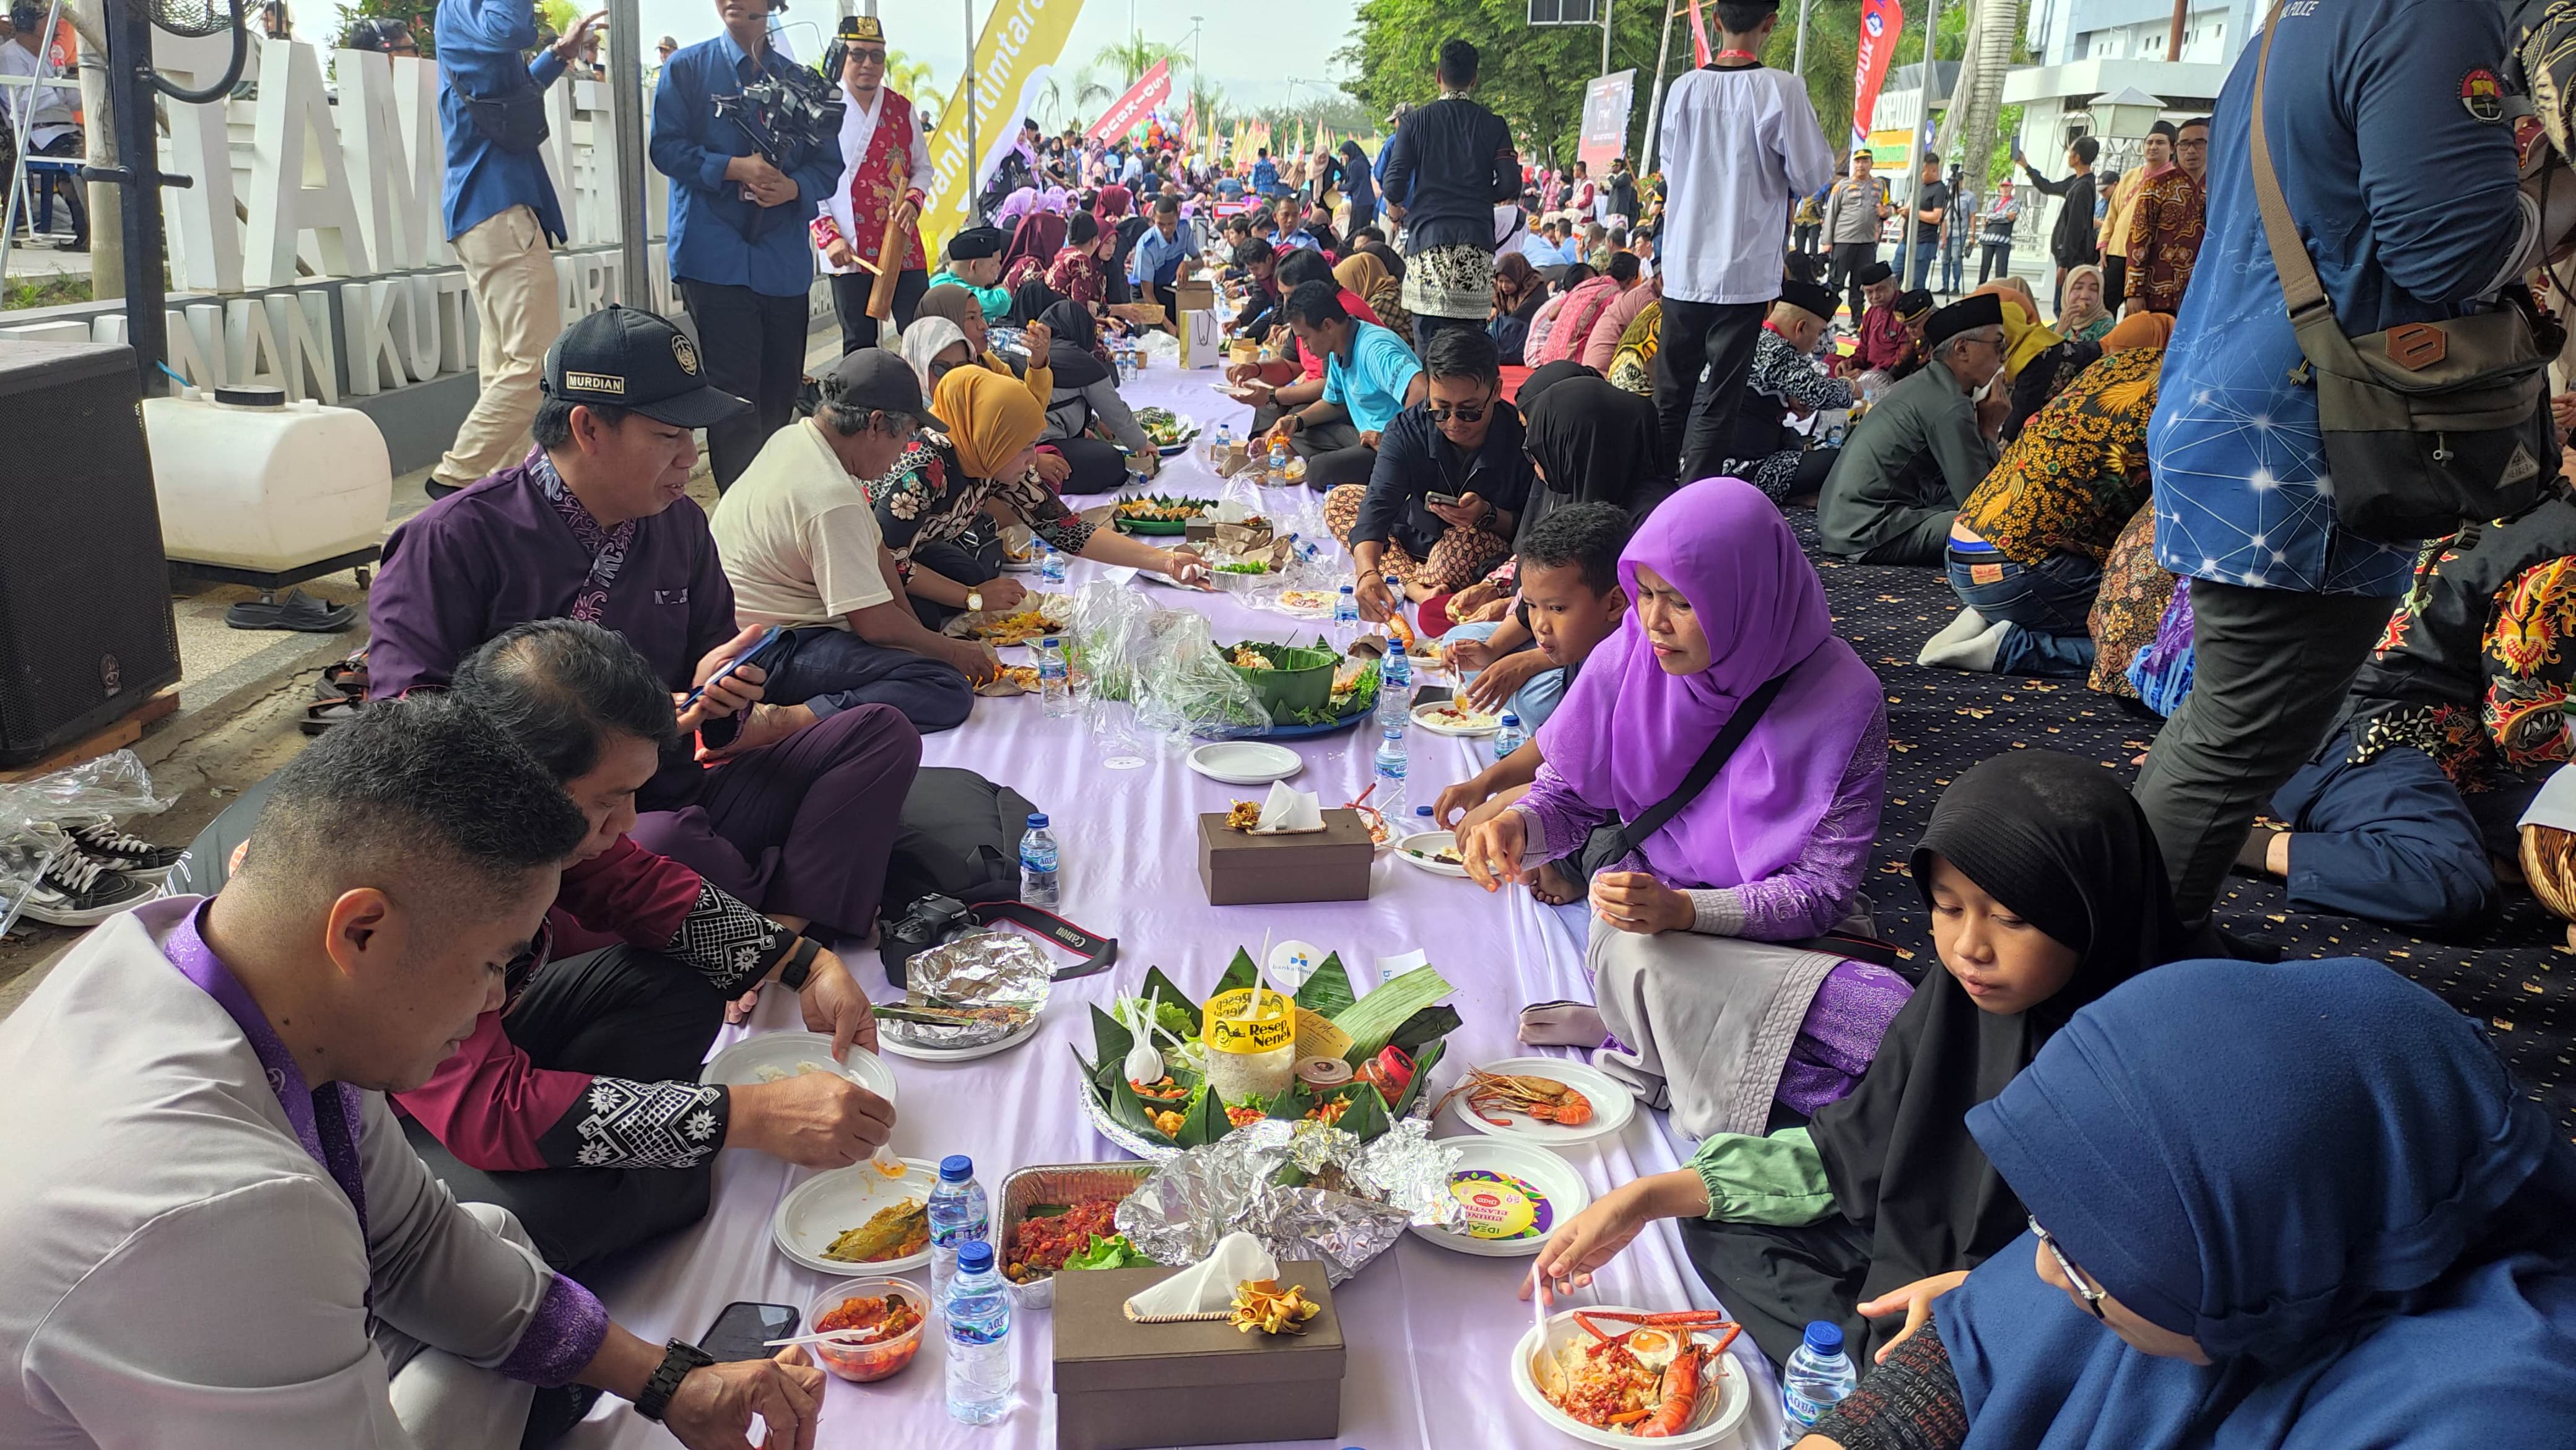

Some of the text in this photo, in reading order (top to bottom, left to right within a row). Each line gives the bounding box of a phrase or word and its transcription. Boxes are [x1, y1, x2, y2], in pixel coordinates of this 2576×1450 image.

[569, 375, 620, 391] MURDIAN
[1055, 926, 1086, 948] Canon
[1249, 1020, 1287, 1036] Resep
[1253, 1026, 1291, 1048] Nenek
[1788, 1393, 1816, 1415] AQUA
